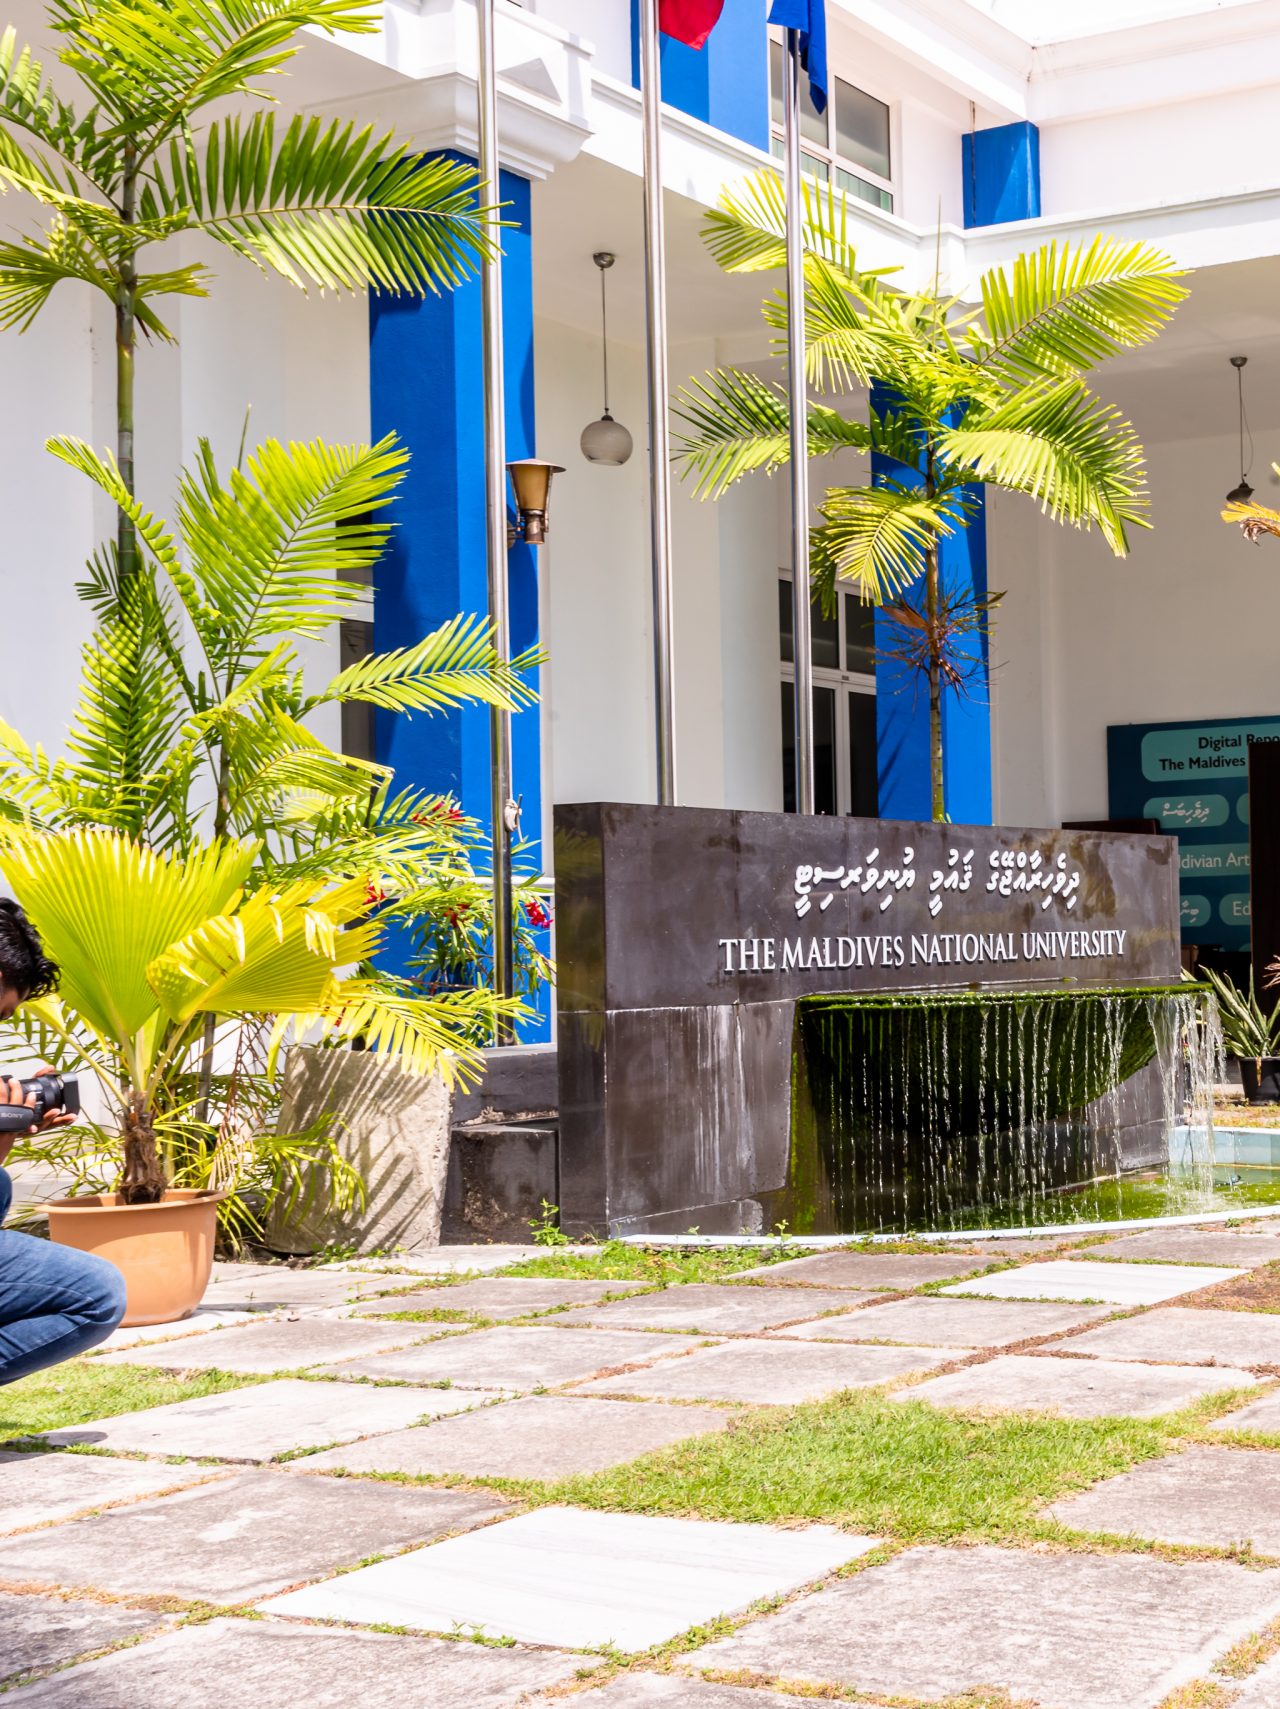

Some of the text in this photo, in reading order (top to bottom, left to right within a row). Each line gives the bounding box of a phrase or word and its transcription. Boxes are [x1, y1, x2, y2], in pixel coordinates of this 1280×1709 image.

[1198, 735, 1242, 752] Digital
[1158, 756, 1246, 771] The Maldives
[1178, 853, 1222, 869] ldivian
[718, 929, 1127, 971] THE MALDIVES NATIONAL UNIVERSITY
